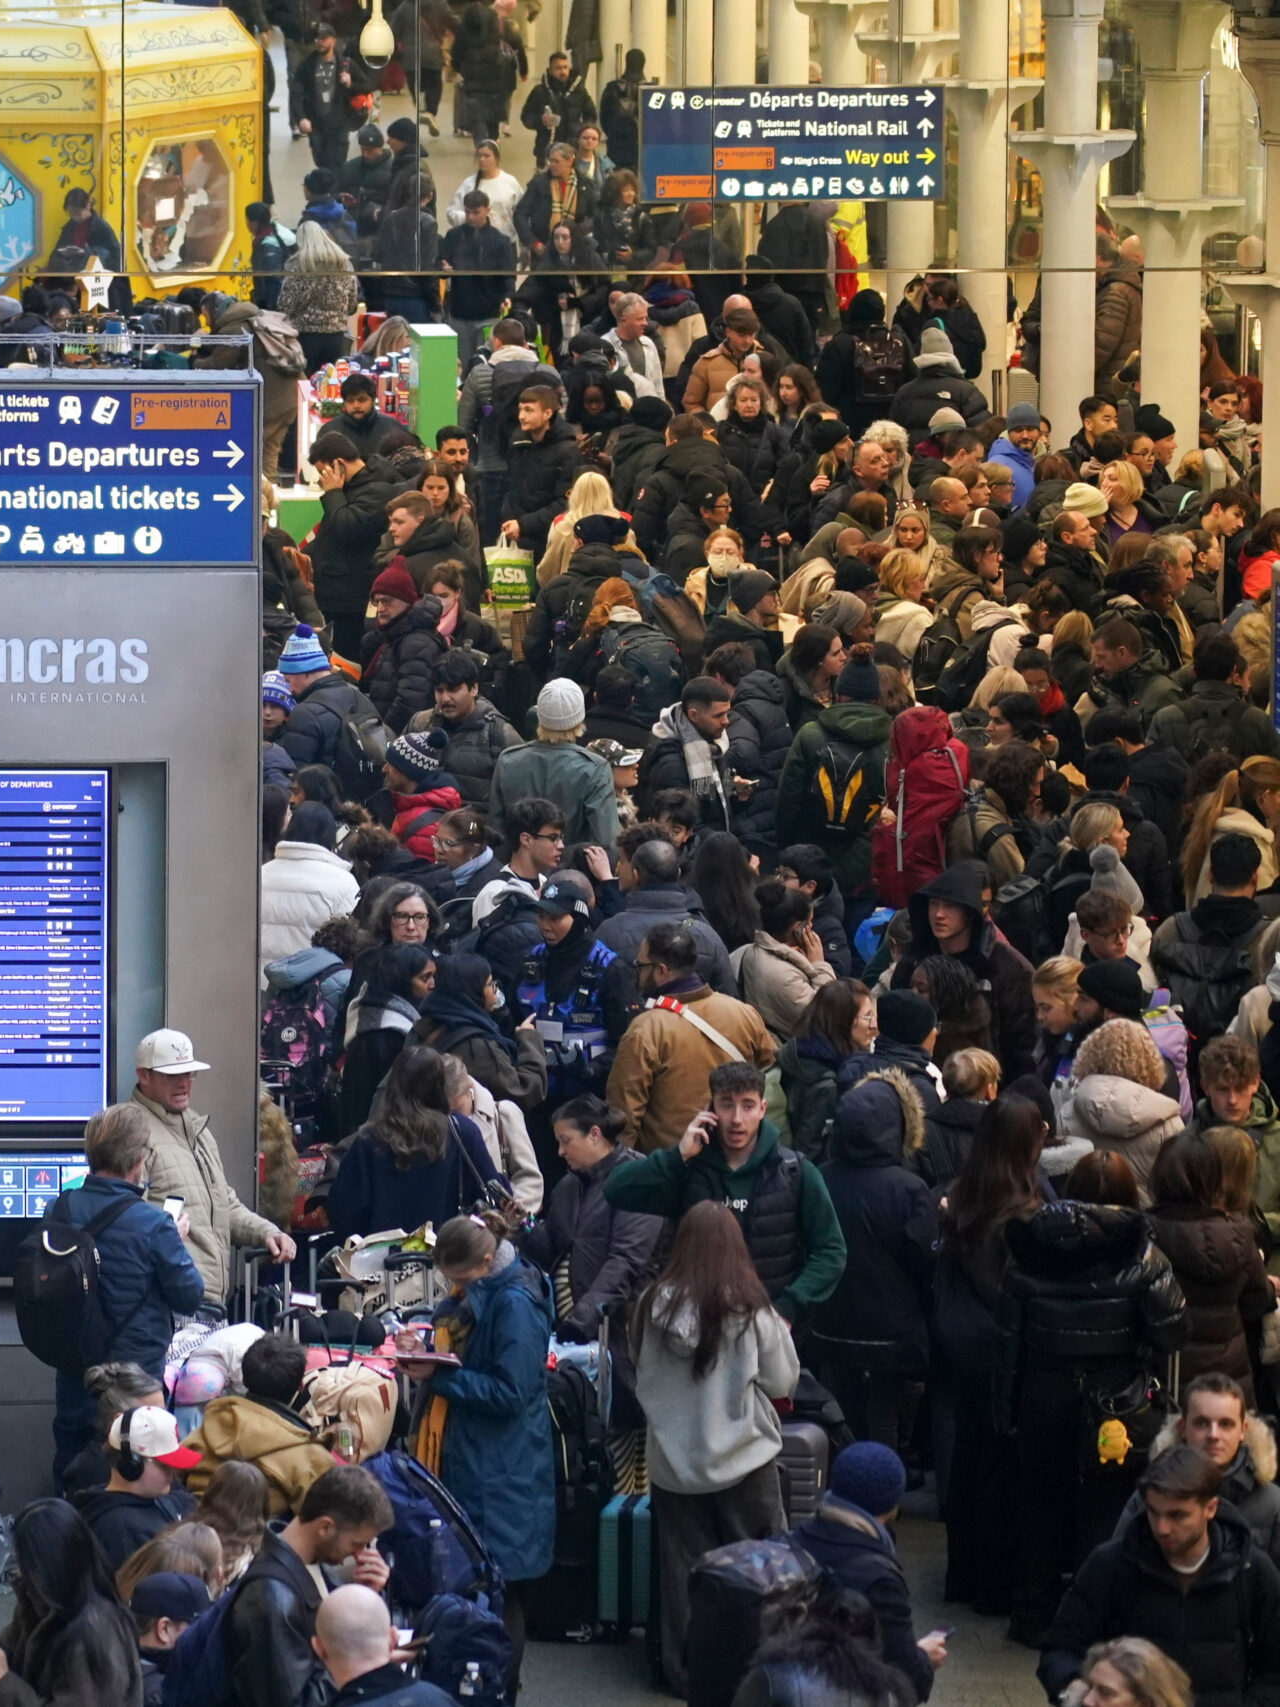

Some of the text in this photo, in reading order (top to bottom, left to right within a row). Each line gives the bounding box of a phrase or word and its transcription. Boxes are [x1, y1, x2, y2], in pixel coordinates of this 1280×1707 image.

[750, 92, 813, 110] Départs
[817, 92, 909, 110] Departures
[757, 119, 800, 128] Tickets and
[805, 121, 908, 136] National Rail
[763, 128, 800, 138] platforms
[794, 157, 842, 166] King's Cross
[845, 150, 909, 167] Way out
[7, 394, 49, 408] tickets
[133, 397, 228, 411] Pre-registration
[215, 410, 227, 426] A
[49, 441, 199, 471] Departures
[109, 484, 199, 509] tickets
[10, 692, 147, 703] INTERNATIONAL
